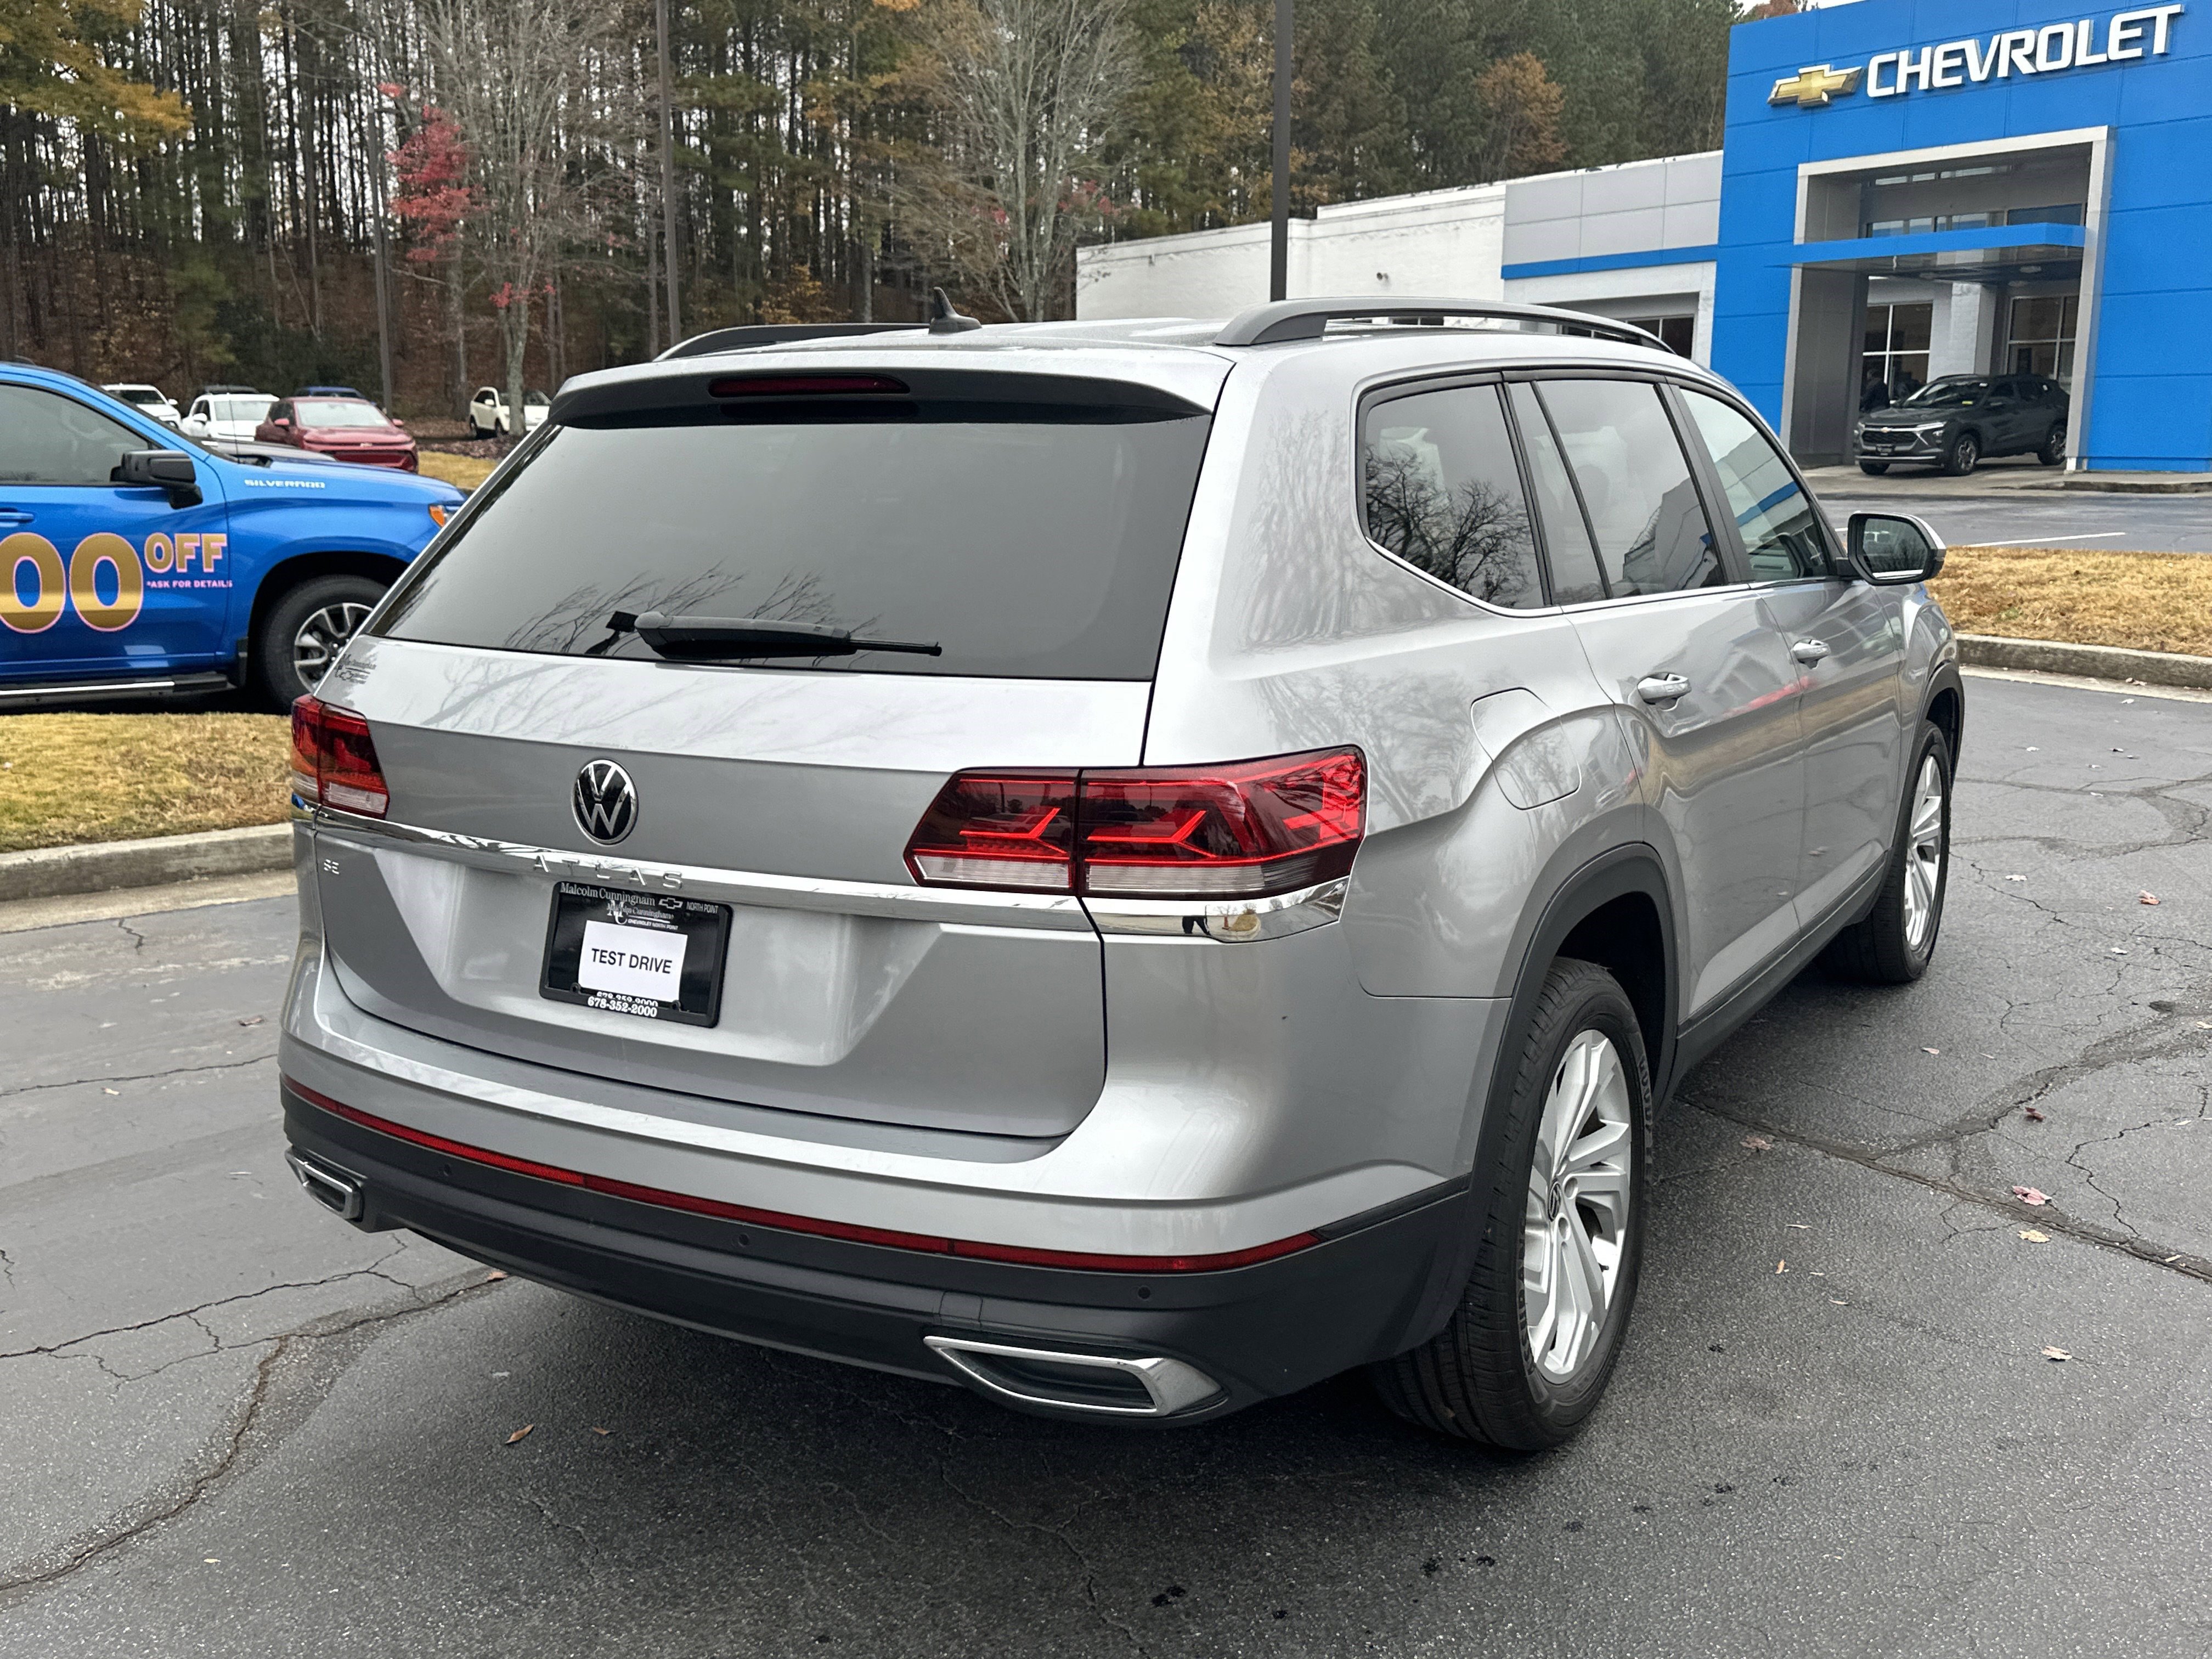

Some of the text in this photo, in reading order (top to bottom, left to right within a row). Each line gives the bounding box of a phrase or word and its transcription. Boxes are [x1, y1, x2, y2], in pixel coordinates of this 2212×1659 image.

[1867, 4, 2183, 98] CHEVROLET
[244, 479, 325, 489] SILVERADO
[144, 532, 228, 573] OFF
[172, 580, 191, 588] FOR
[193, 579, 233, 588] DETAILS
[324, 859, 340, 874] SE
[533, 854, 683, 890] ATLAS
[560, 882, 719, 914] Malcolm Cunningham NORTH POINT
[591, 948, 673, 974] TEST DRIVE
[588, 996, 658, 1018] 678-352-2000
